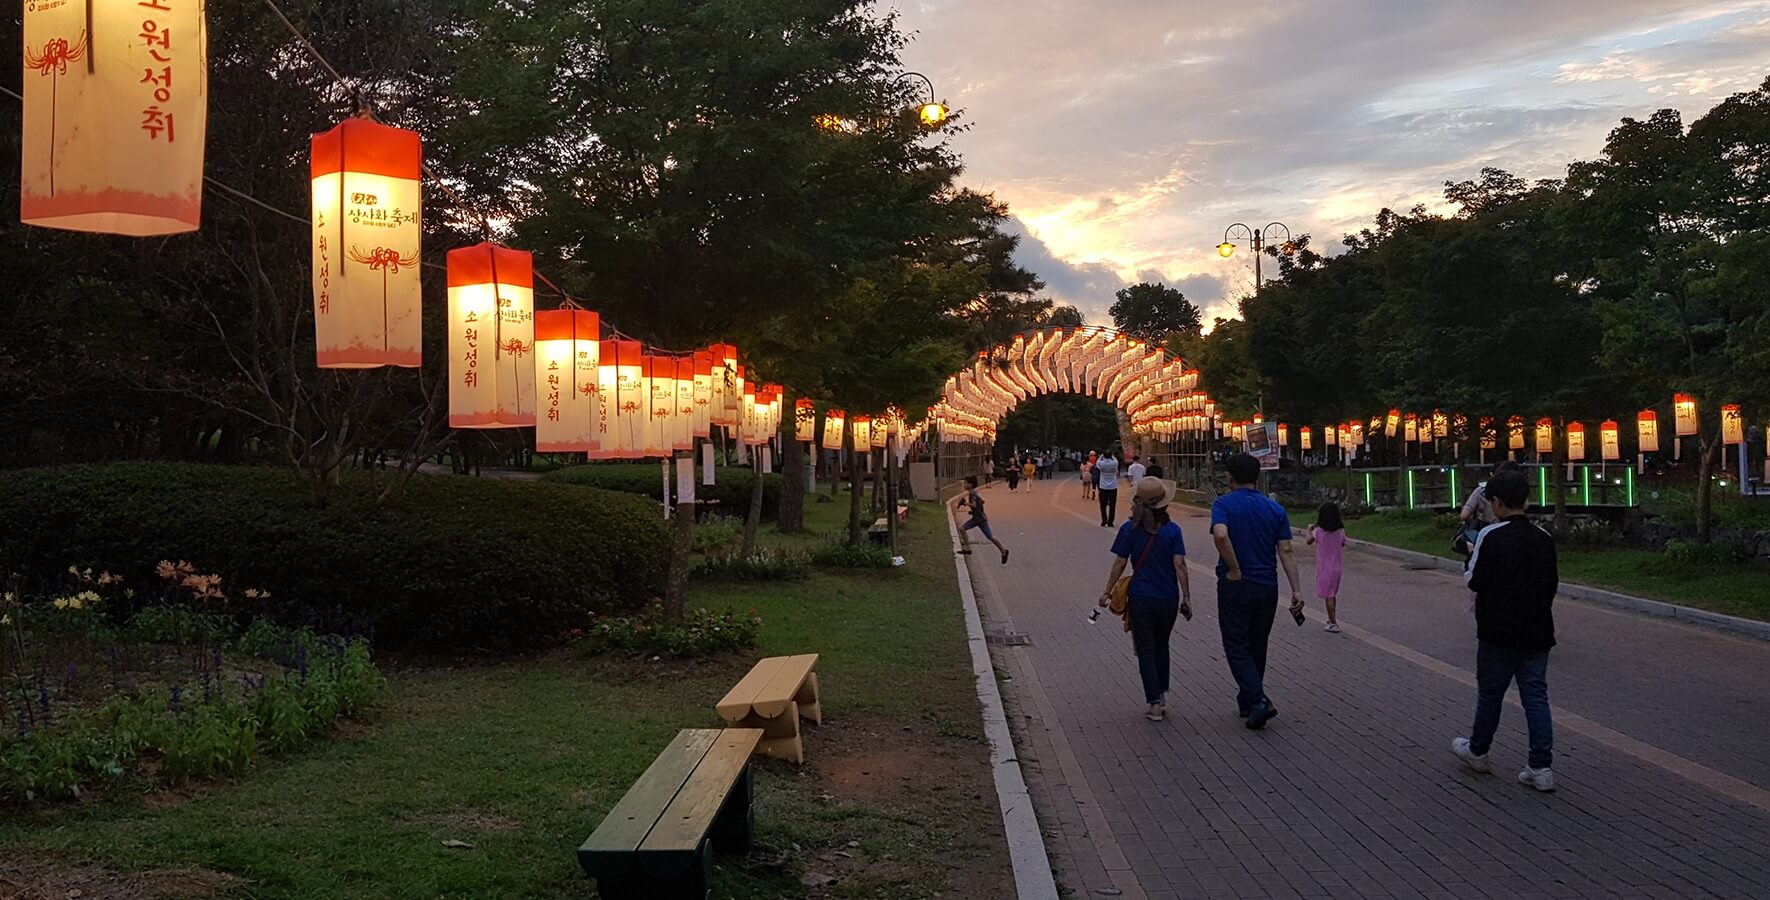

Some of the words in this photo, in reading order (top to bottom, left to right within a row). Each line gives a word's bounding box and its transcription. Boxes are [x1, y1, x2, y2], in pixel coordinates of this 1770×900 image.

[348, 208, 387, 224] 상사화
[390, 207, 418, 227] 축제
[464, 310, 478, 388] 소원성취
[547, 360, 560, 422] 소원성취
